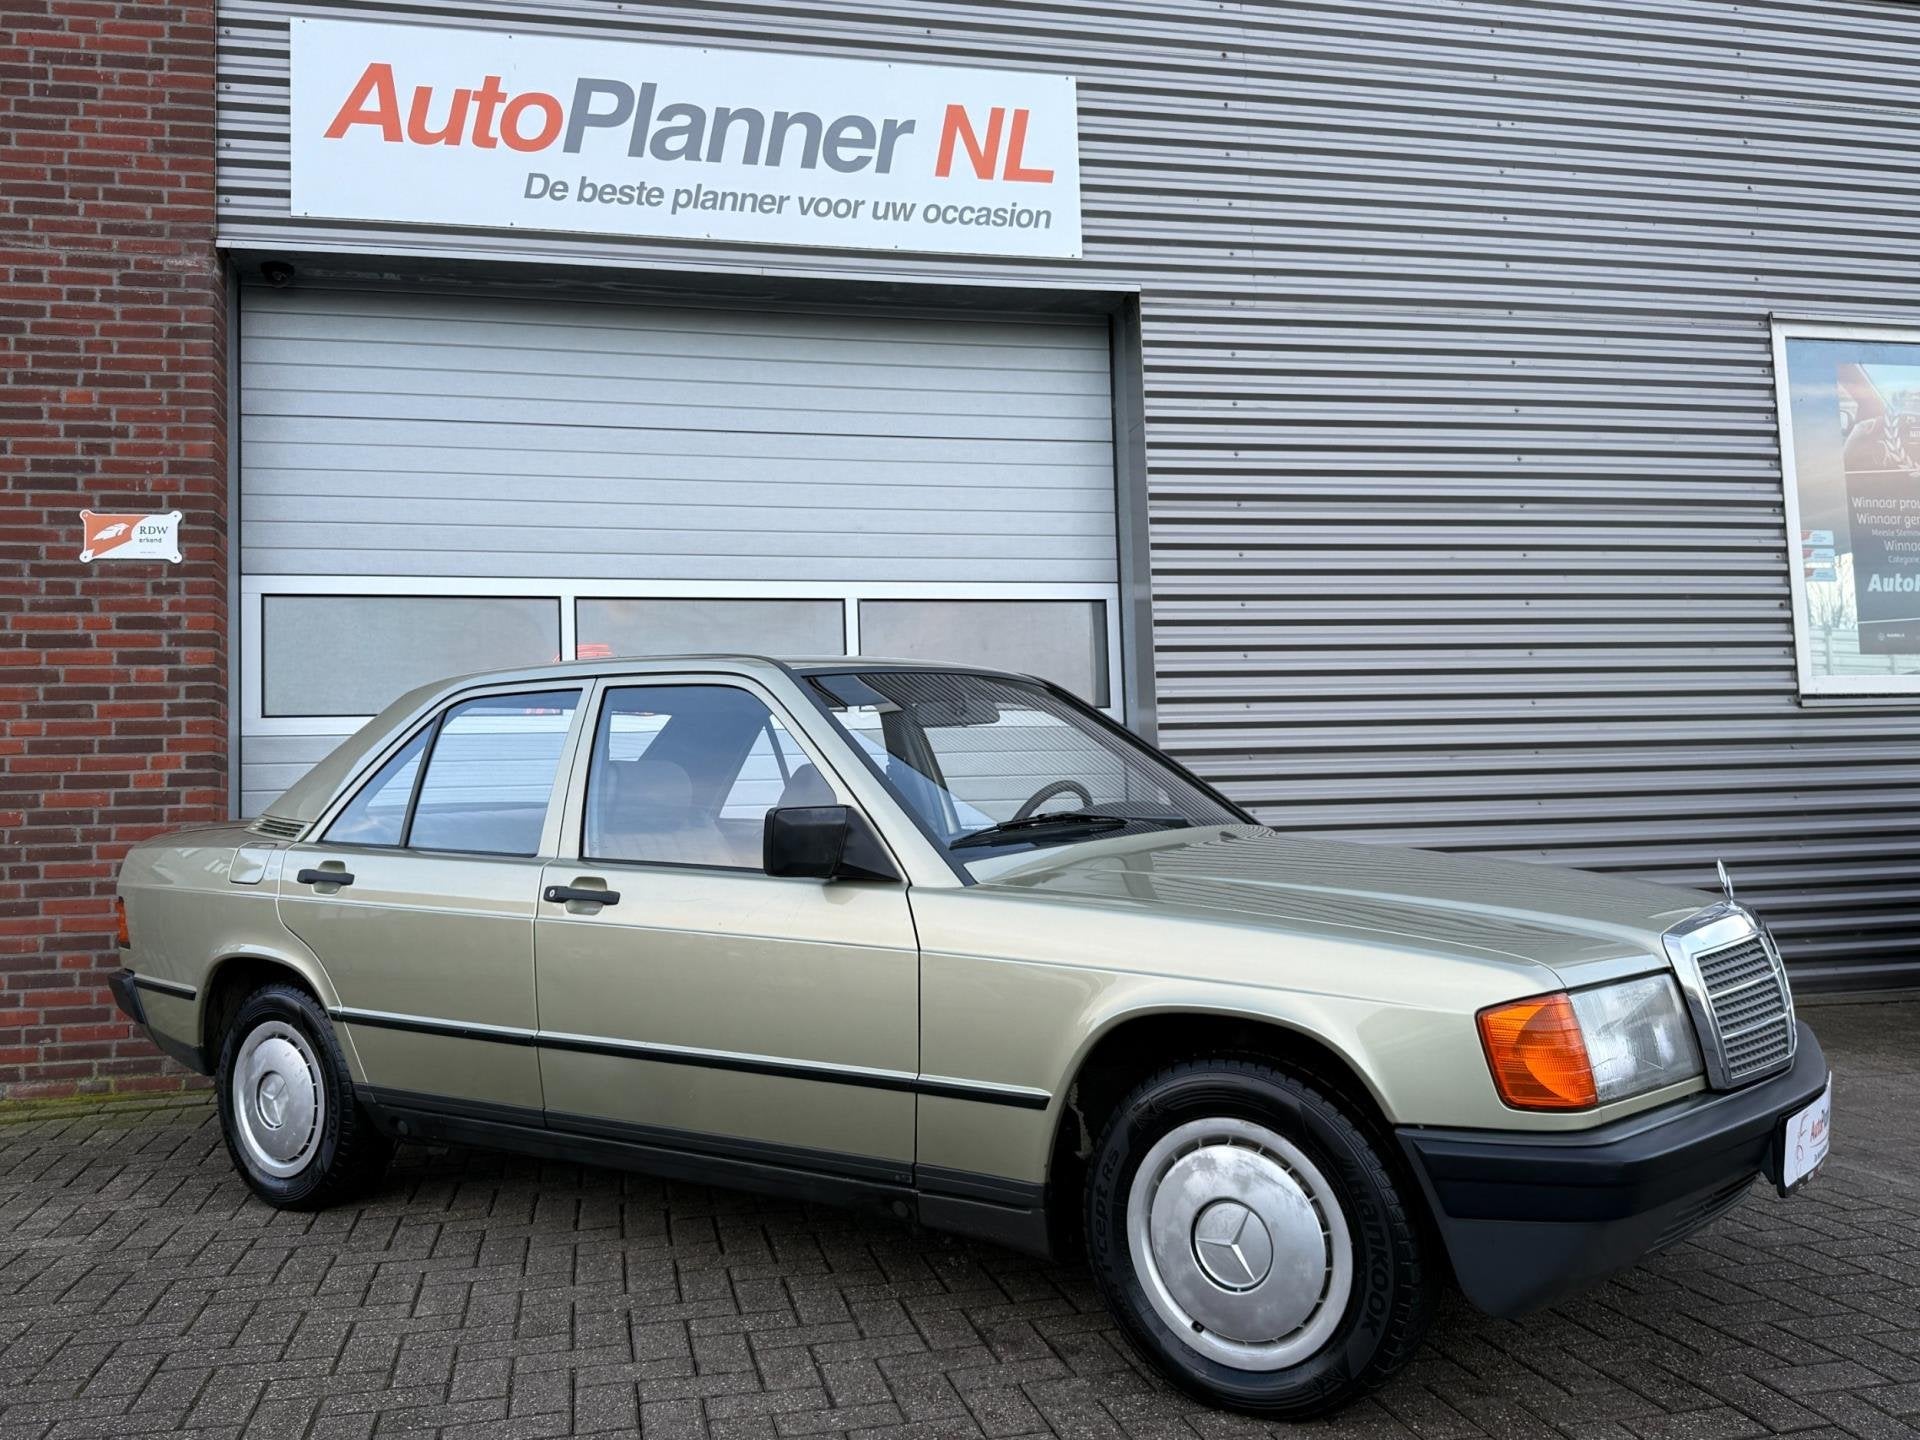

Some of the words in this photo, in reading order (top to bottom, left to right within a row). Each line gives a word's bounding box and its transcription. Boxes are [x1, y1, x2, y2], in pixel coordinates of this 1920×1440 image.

[322, 62, 917, 176] AutoPlanner
[934, 103, 1055, 184] NL
[523, 172, 570, 202] De
[576, 176, 665, 208] beste
[670, 183, 792, 217] planner
[797, 195, 867, 220] voor
[871, 200, 918, 222] uw
[922, 202, 1053, 230] occasion
[1851, 496, 1897, 509] Winnaar
[1856, 512, 1902, 525] Winnaar
[139, 525, 169, 535] RDW
